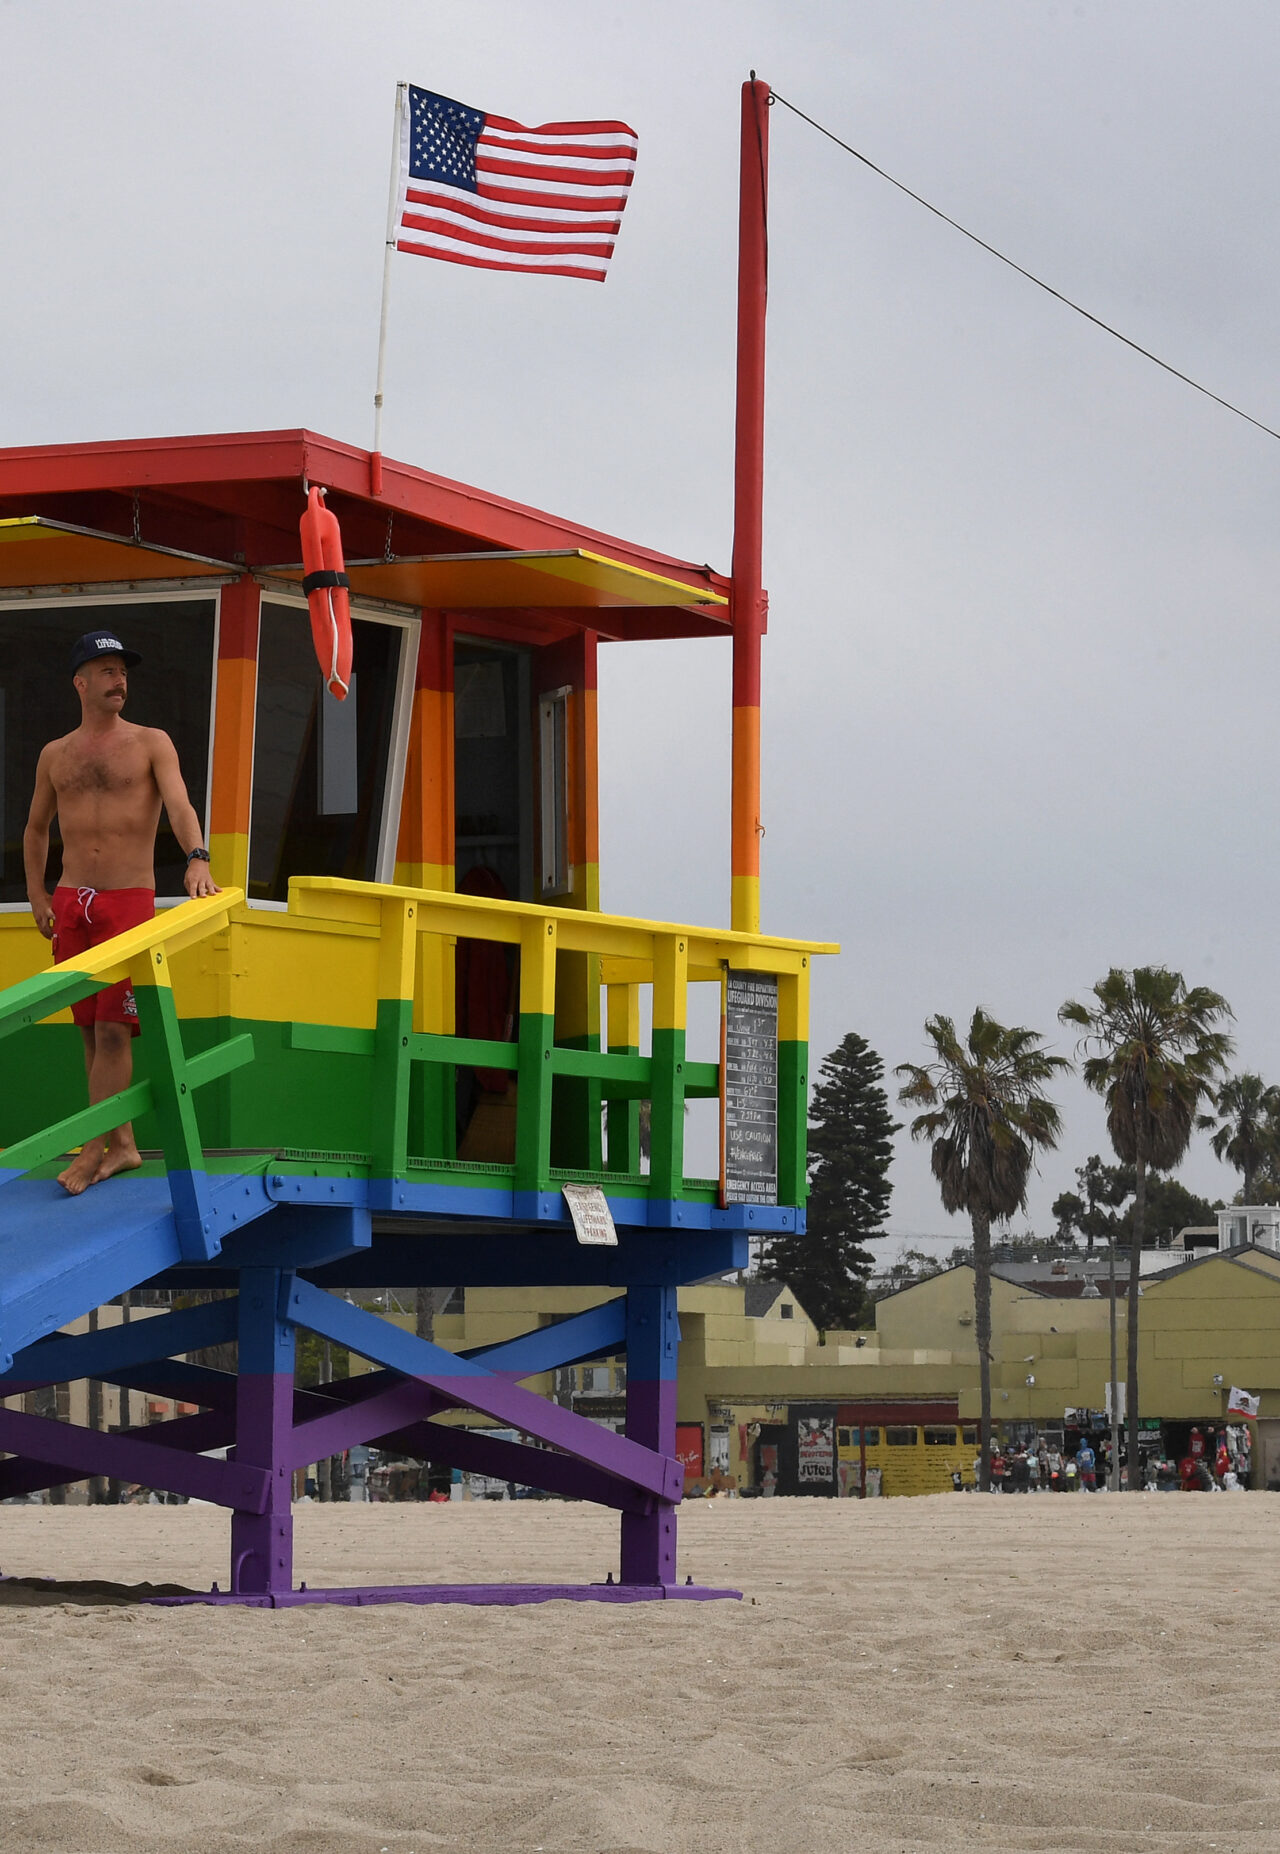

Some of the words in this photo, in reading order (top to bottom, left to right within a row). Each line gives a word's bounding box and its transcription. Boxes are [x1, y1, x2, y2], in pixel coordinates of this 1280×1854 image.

[728, 991, 754, 1005] LIFEGUARD
[755, 993, 777, 1008] DIVISION
[730, 1130, 742, 1142] USE
[745, 1131, 771, 1144] CAUTION
[800, 1464, 832, 1477] JUICE
